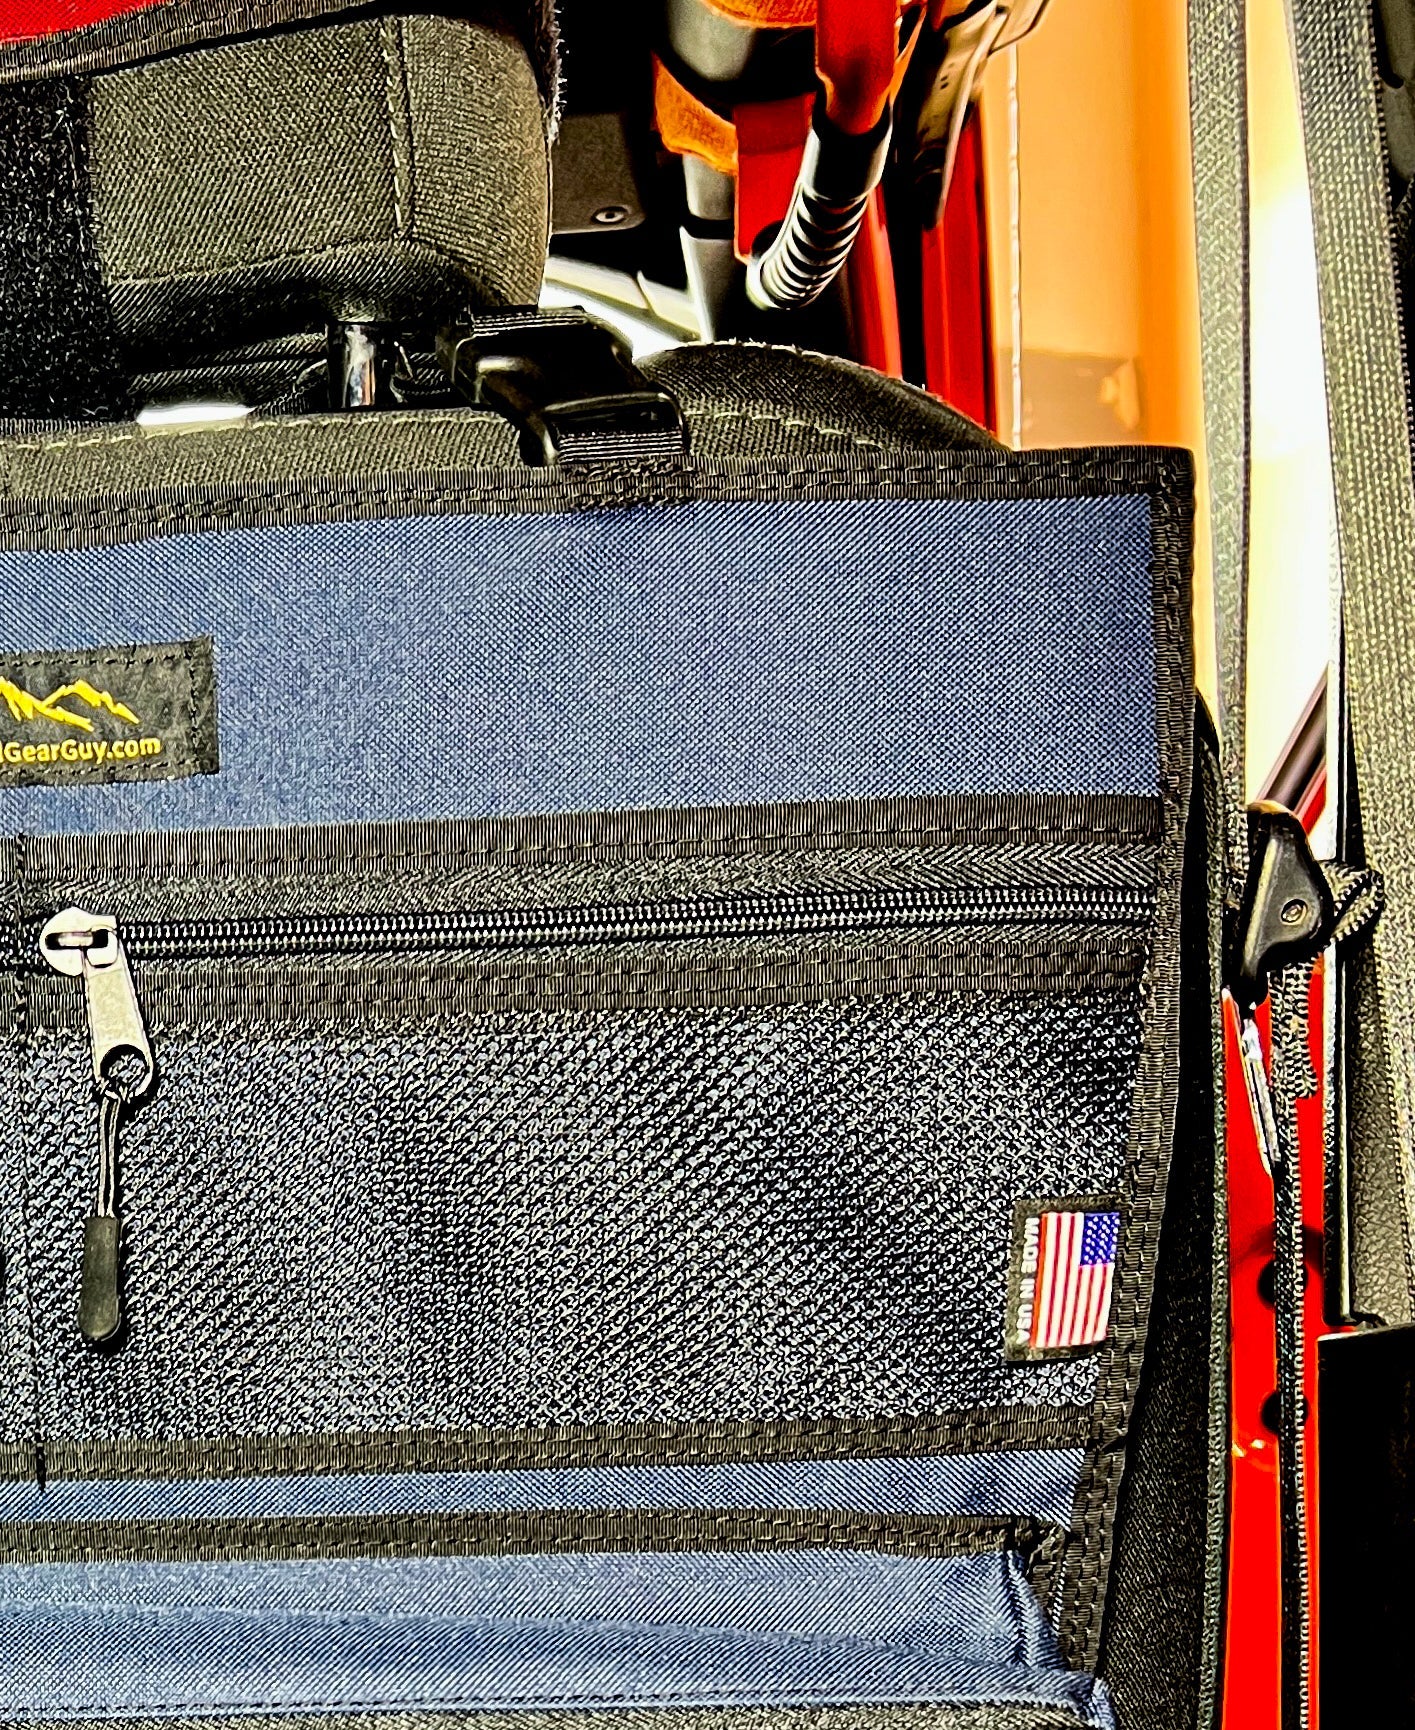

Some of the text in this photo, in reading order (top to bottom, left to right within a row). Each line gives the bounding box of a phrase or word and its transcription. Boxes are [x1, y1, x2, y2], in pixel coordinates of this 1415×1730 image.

[1016, 1217, 1040, 1345] MADE IN USA
